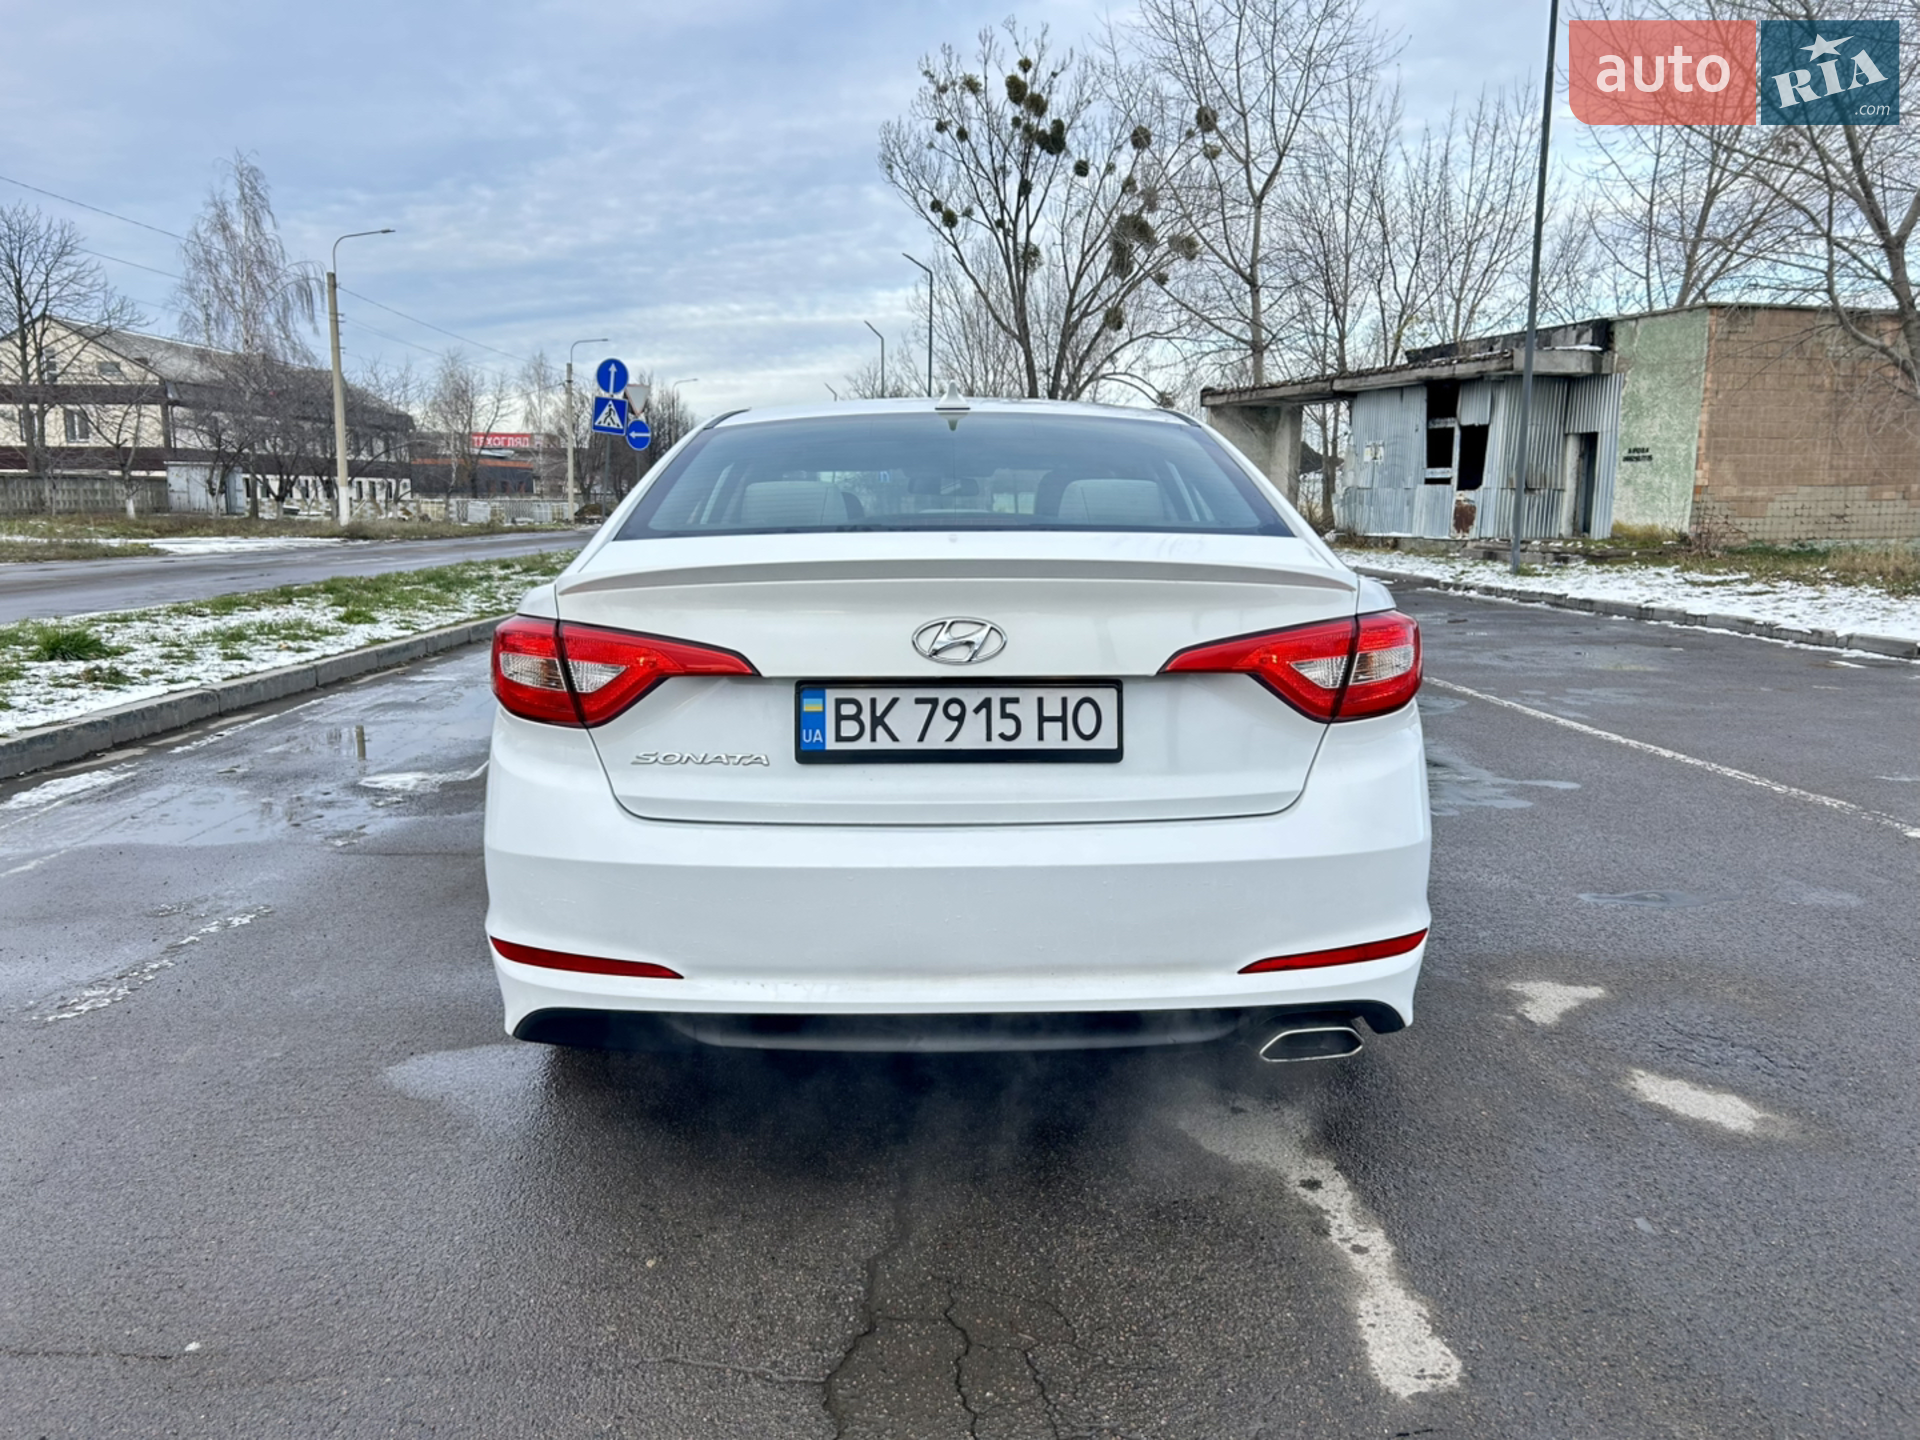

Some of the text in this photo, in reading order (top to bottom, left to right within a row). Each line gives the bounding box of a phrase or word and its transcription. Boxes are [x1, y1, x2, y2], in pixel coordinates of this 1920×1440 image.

[834, 696, 1102, 743] BK 7915 HO
[802, 728, 823, 743] UA
[631, 751, 770, 767] SONATA
